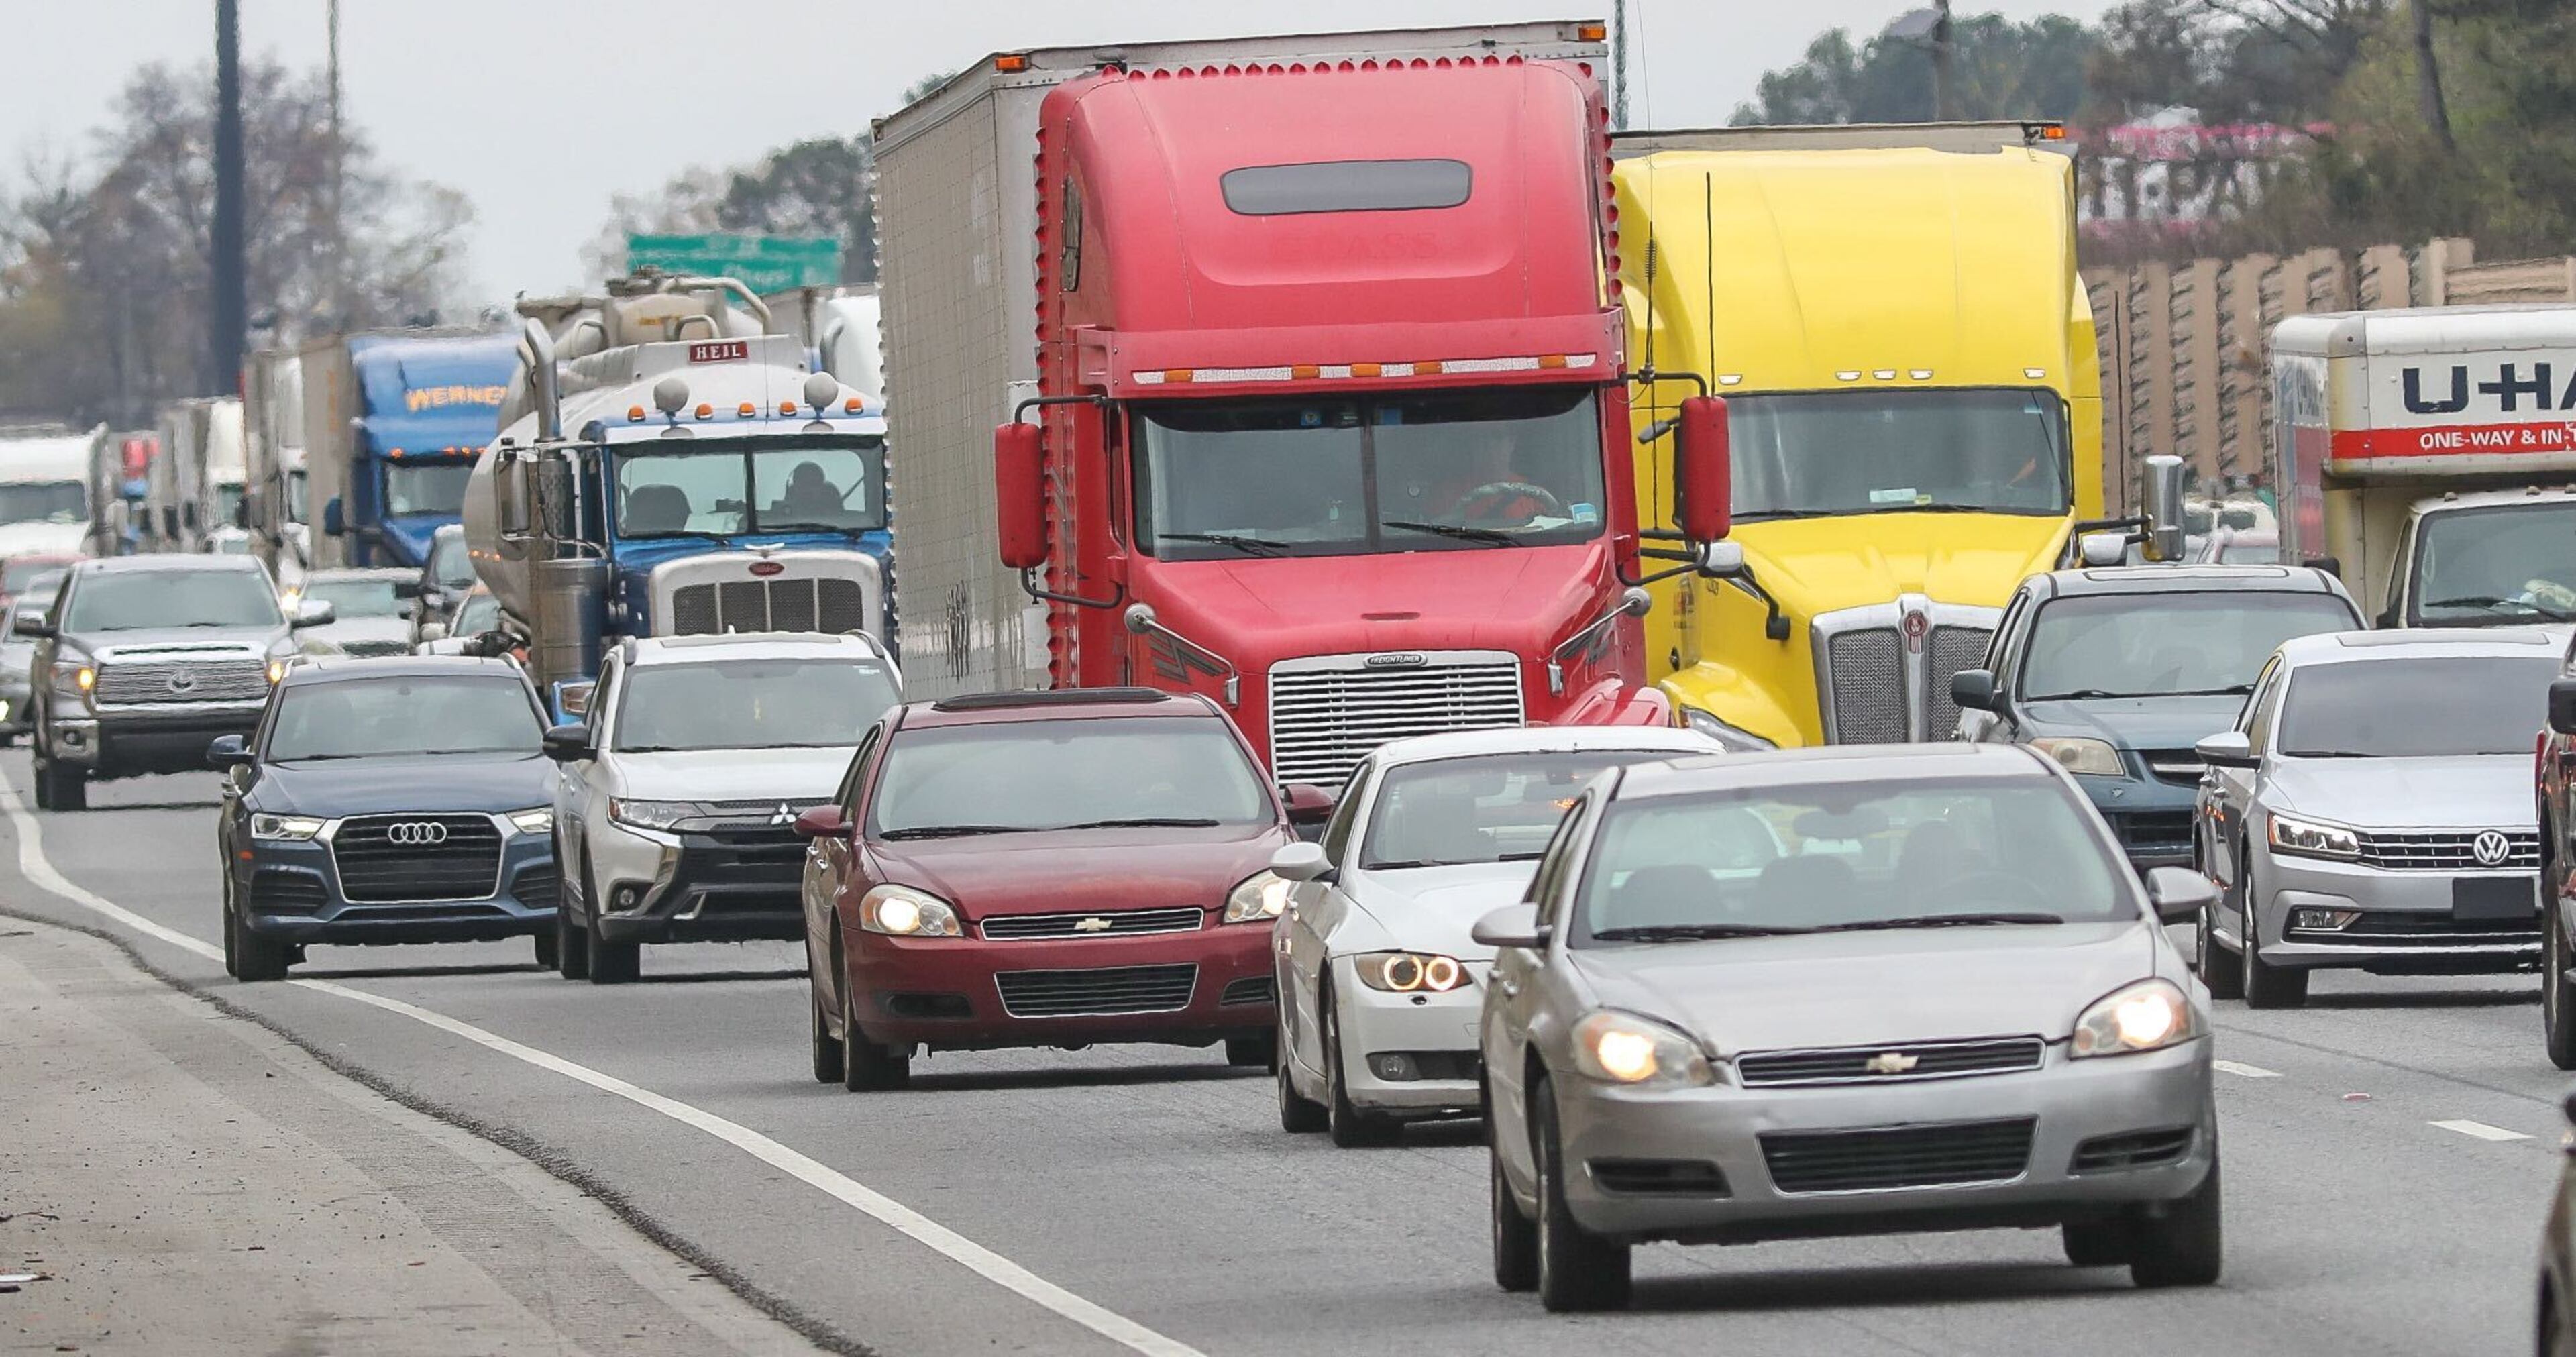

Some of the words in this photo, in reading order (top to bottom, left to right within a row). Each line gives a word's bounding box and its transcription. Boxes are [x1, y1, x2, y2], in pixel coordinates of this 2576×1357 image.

[695, 345, 741, 360] HEIL
[2420, 431, 2514, 449] ONE-WAY
[2520, 429, 2536, 445] &
